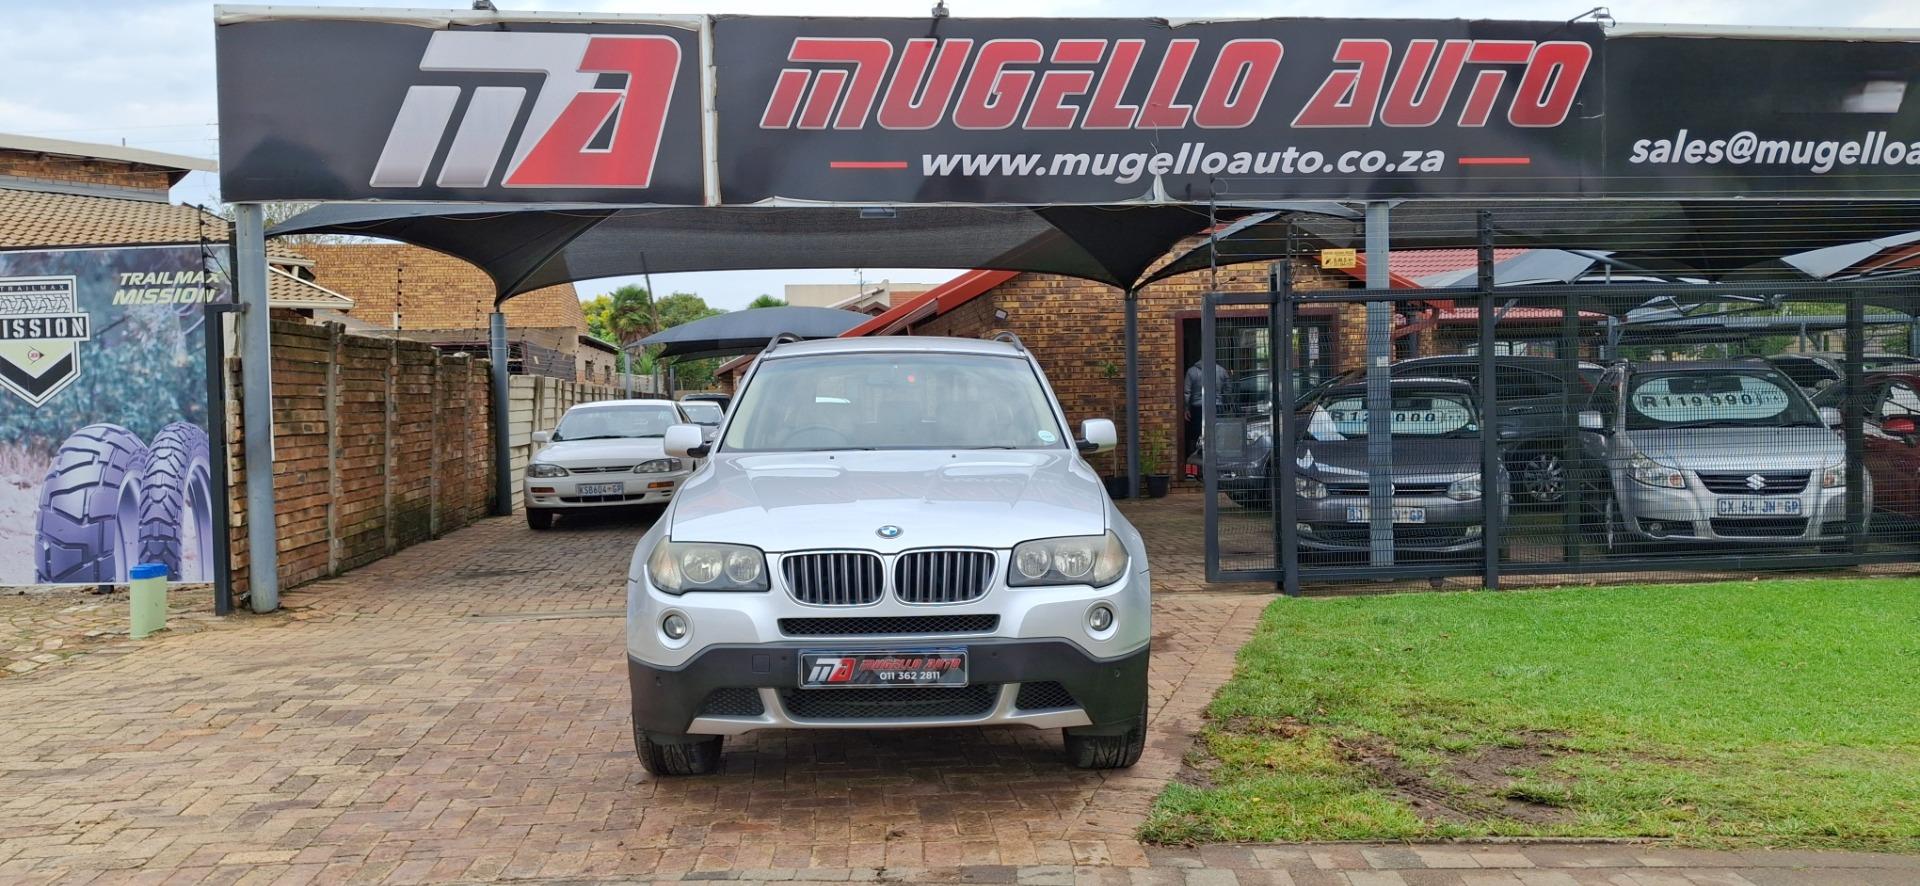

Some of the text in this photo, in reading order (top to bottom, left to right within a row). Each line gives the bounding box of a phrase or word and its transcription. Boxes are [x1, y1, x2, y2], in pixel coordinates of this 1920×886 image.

[760, 36, 1593, 130] MUGELLO AUTO
[1629, 129, 1920, 174] sales@mugelloa
[921, 147, 1446, 186] www.mugelloauto.co.za
[119, 270, 222, 286] TRAILMAX
[111, 287, 216, 306] MISSION
[1720, 501, 1798, 512] CX 64 JN GP
[924, 656, 961, 670] AUTO
[879, 672, 940, 681] 011 362 2811
